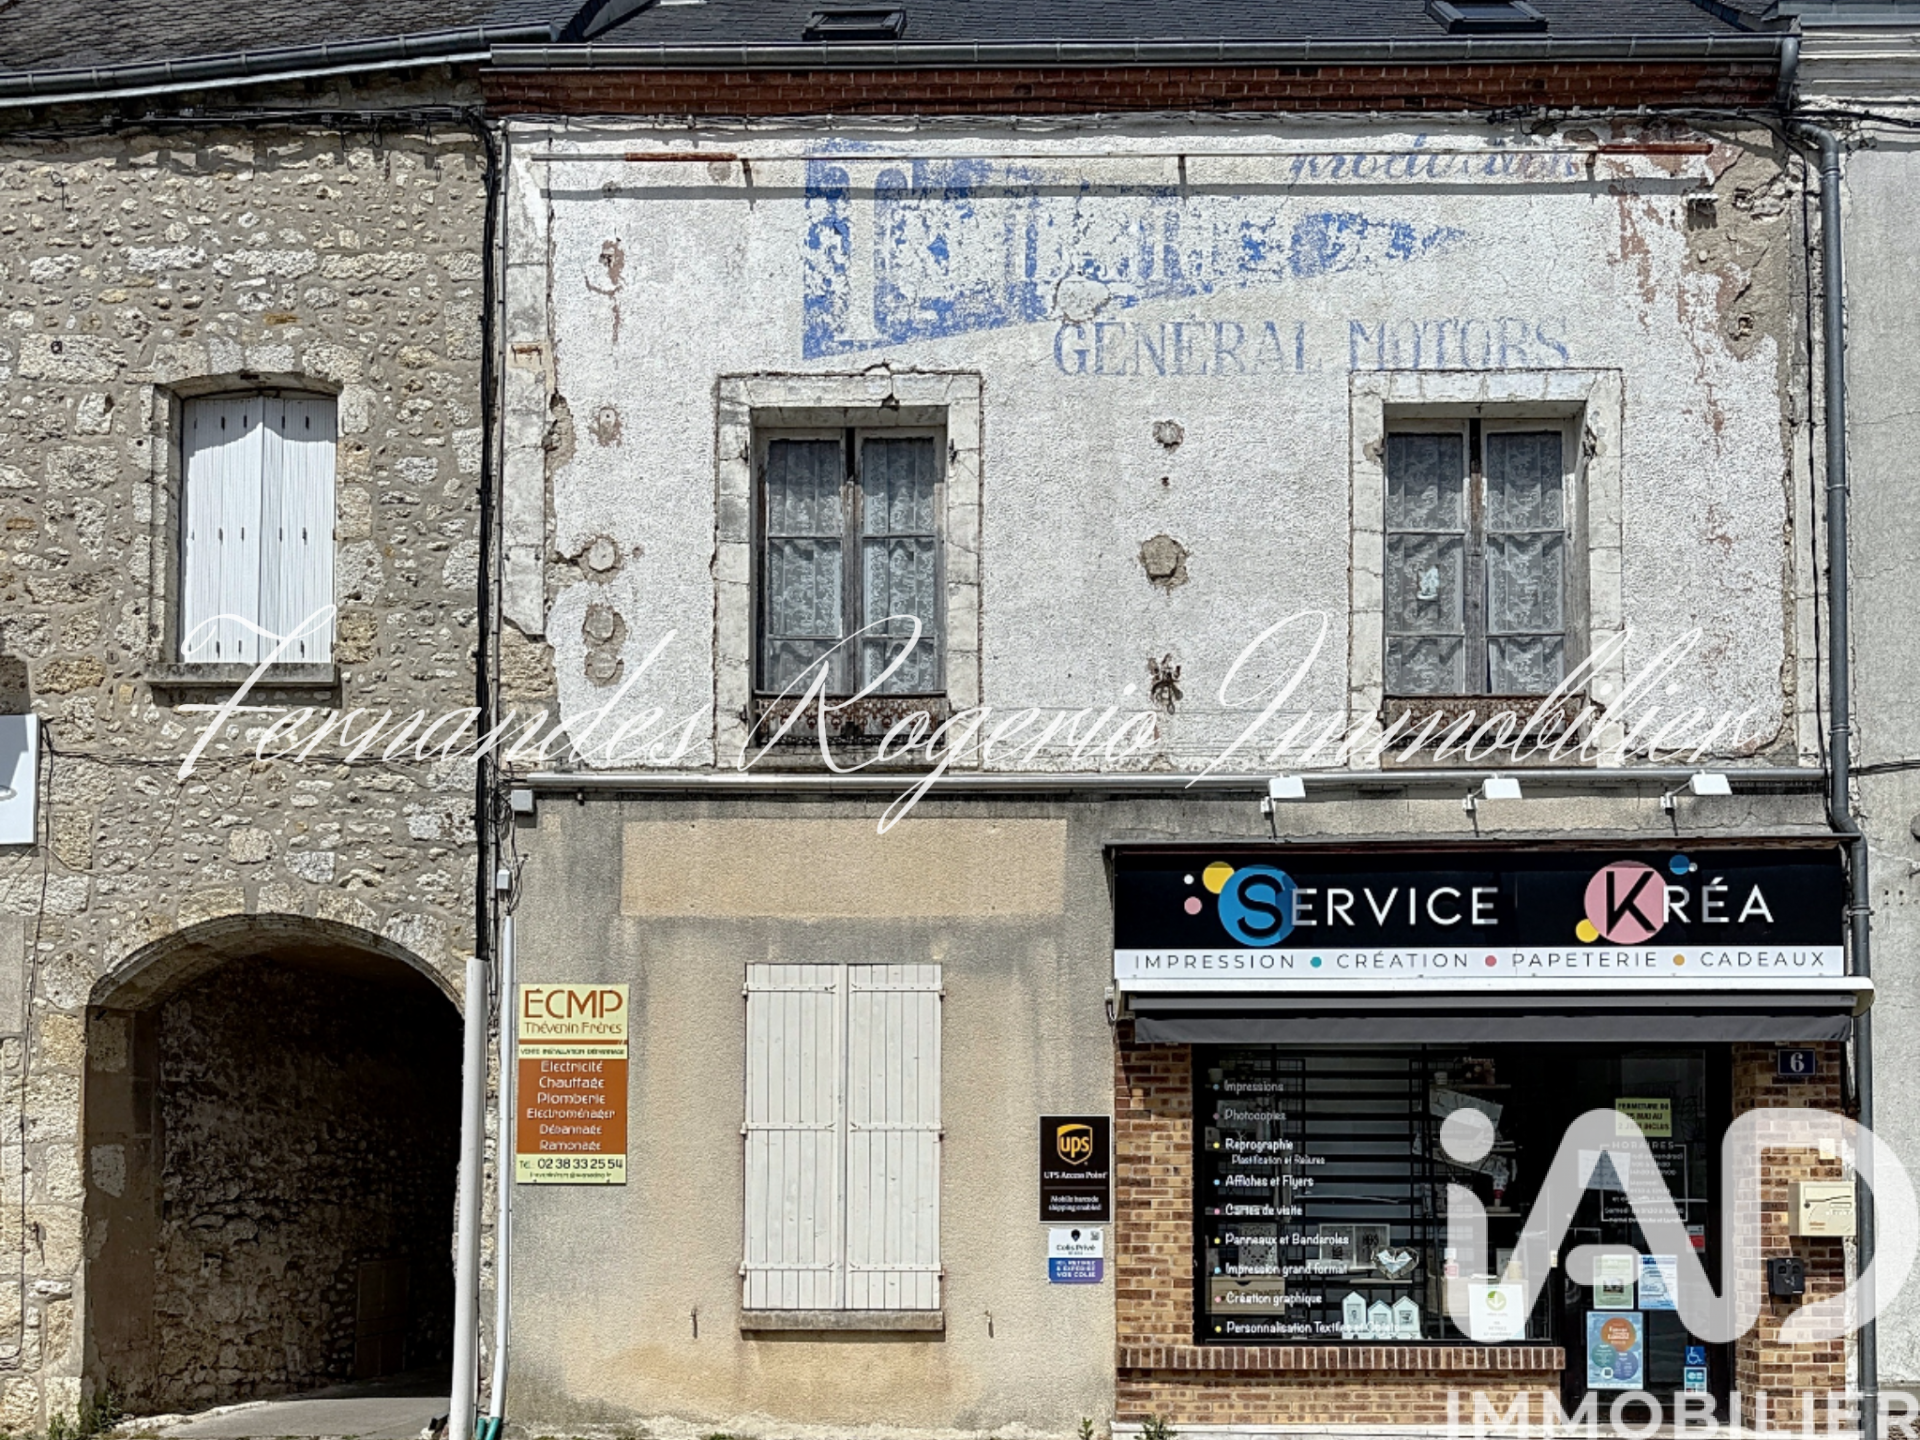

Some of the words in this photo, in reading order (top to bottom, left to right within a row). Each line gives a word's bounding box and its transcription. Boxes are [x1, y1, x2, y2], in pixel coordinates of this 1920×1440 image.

[1053, 319, 1322, 376] GENERAL
[1348, 317, 1570, 370] MOTORS
[1135, 954, 1296, 970] IMPRESSION
[1336, 950, 1469, 969] CRÉATION
[1511, 952, 1658, 968] PAPETERIE
[1700, 951, 1825, 967] CADEAUX
[524, 988, 624, 1019] ECMP
[525, 1021, 579, 1034] Thévenin
[582, 1021, 622, 1034] Frères
[1790, 1052, 1805, 1073] 6
[539, 1076, 604, 1090] Chauffage
[1224, 1079, 1284, 1095] Impressions
[537, 1092, 606, 1104] Plomberie
[1224, 1108, 1287, 1124] Photocopies
[540, 1139, 602, 1152] Ramonage
[1060, 1136, 1090, 1158] ups
[1225, 1138, 1293, 1153] Reprographie
[537, 1158, 553, 1170] 02
[555, 1158, 571, 1170] 38
[573, 1158, 588, 1170] 33
[590, 1158, 606, 1170] 25
[607, 1158, 623, 1170] 54
[1225, 1174, 1268, 1187] Affiches
[1270, 1176, 1279, 1187] et
[1282, 1174, 1314, 1190] Flyers
[1225, 1203, 1260, 1215] Cartes
[1262, 1204, 1274, 1215] de
[1276, 1205, 1303, 1215] visite
[1225, 1232, 1277, 1245] Panneaux
[1279, 1235, 1289, 1245] et
[1292, 1232, 1349, 1245] Banderoles
[1225, 1262, 1280, 1277] Impression
[1282, 1263, 1311, 1277] grand
[1314, 1262, 1348, 1274] format
[1226, 1290, 1271, 1304] Création
[1273, 1291, 1322, 1306] graphique
[1226, 1321, 1313, 1334] Personnalisation
